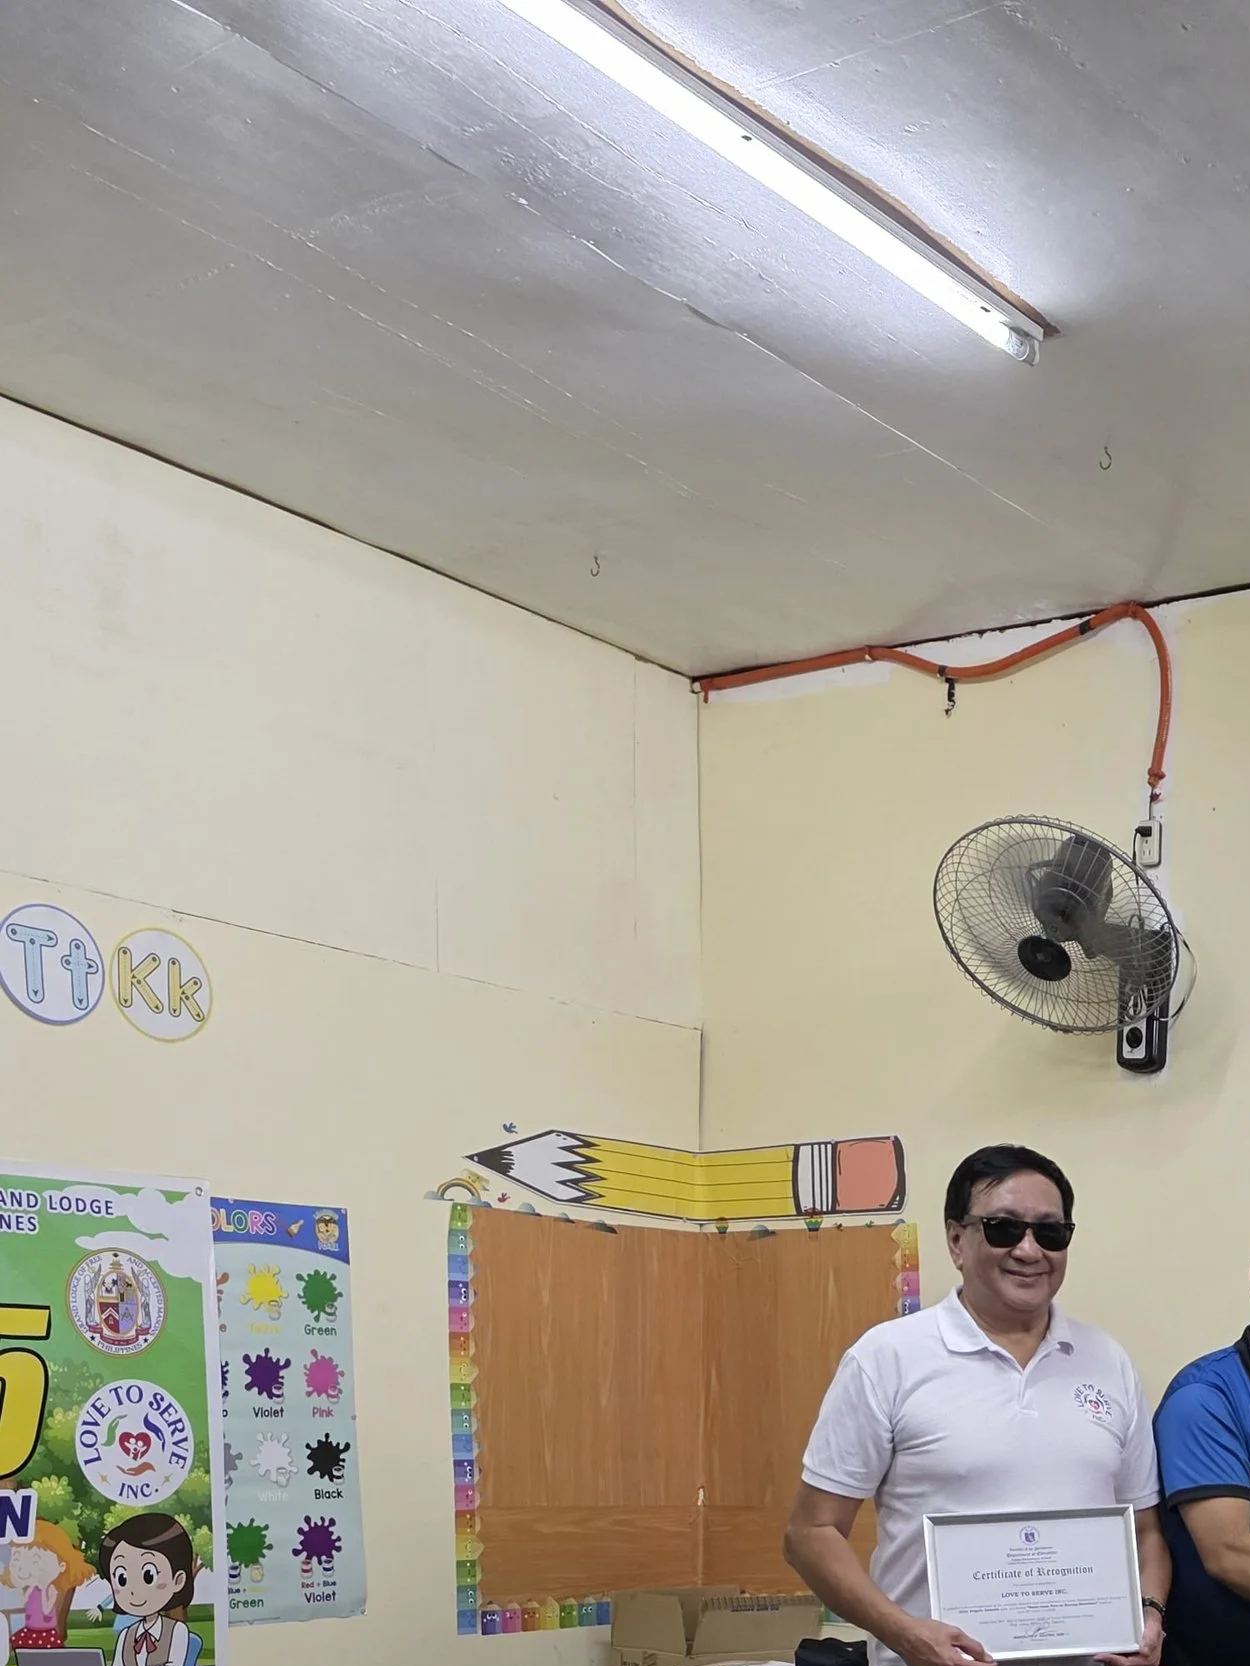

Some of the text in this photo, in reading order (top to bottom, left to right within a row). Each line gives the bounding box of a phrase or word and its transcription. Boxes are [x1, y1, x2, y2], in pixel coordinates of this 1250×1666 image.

[6, 923, 98, 1010] Tt
[115, 947, 206, 1022] Kk
[49, 1194, 114, 1215] LODGE
[127, 1256, 144, 1270] AND
[304, 1323, 337, 1336] Green
[252, 1406, 285, 1418] Violet
[312, 1406, 334, 1418] Pink
[79, 1384, 189, 1470] LOVE TO SERVE
[118, 1482, 159, 1500] INC.
[314, 1488, 344, 1500] Black
[973, 1565, 1094, 1581] Certificate of Recognition
[304, 1590, 337, 1603] Violet
[1001, 1590, 1019, 1599] LOVE
[229, 1598, 264, 1609] Green
